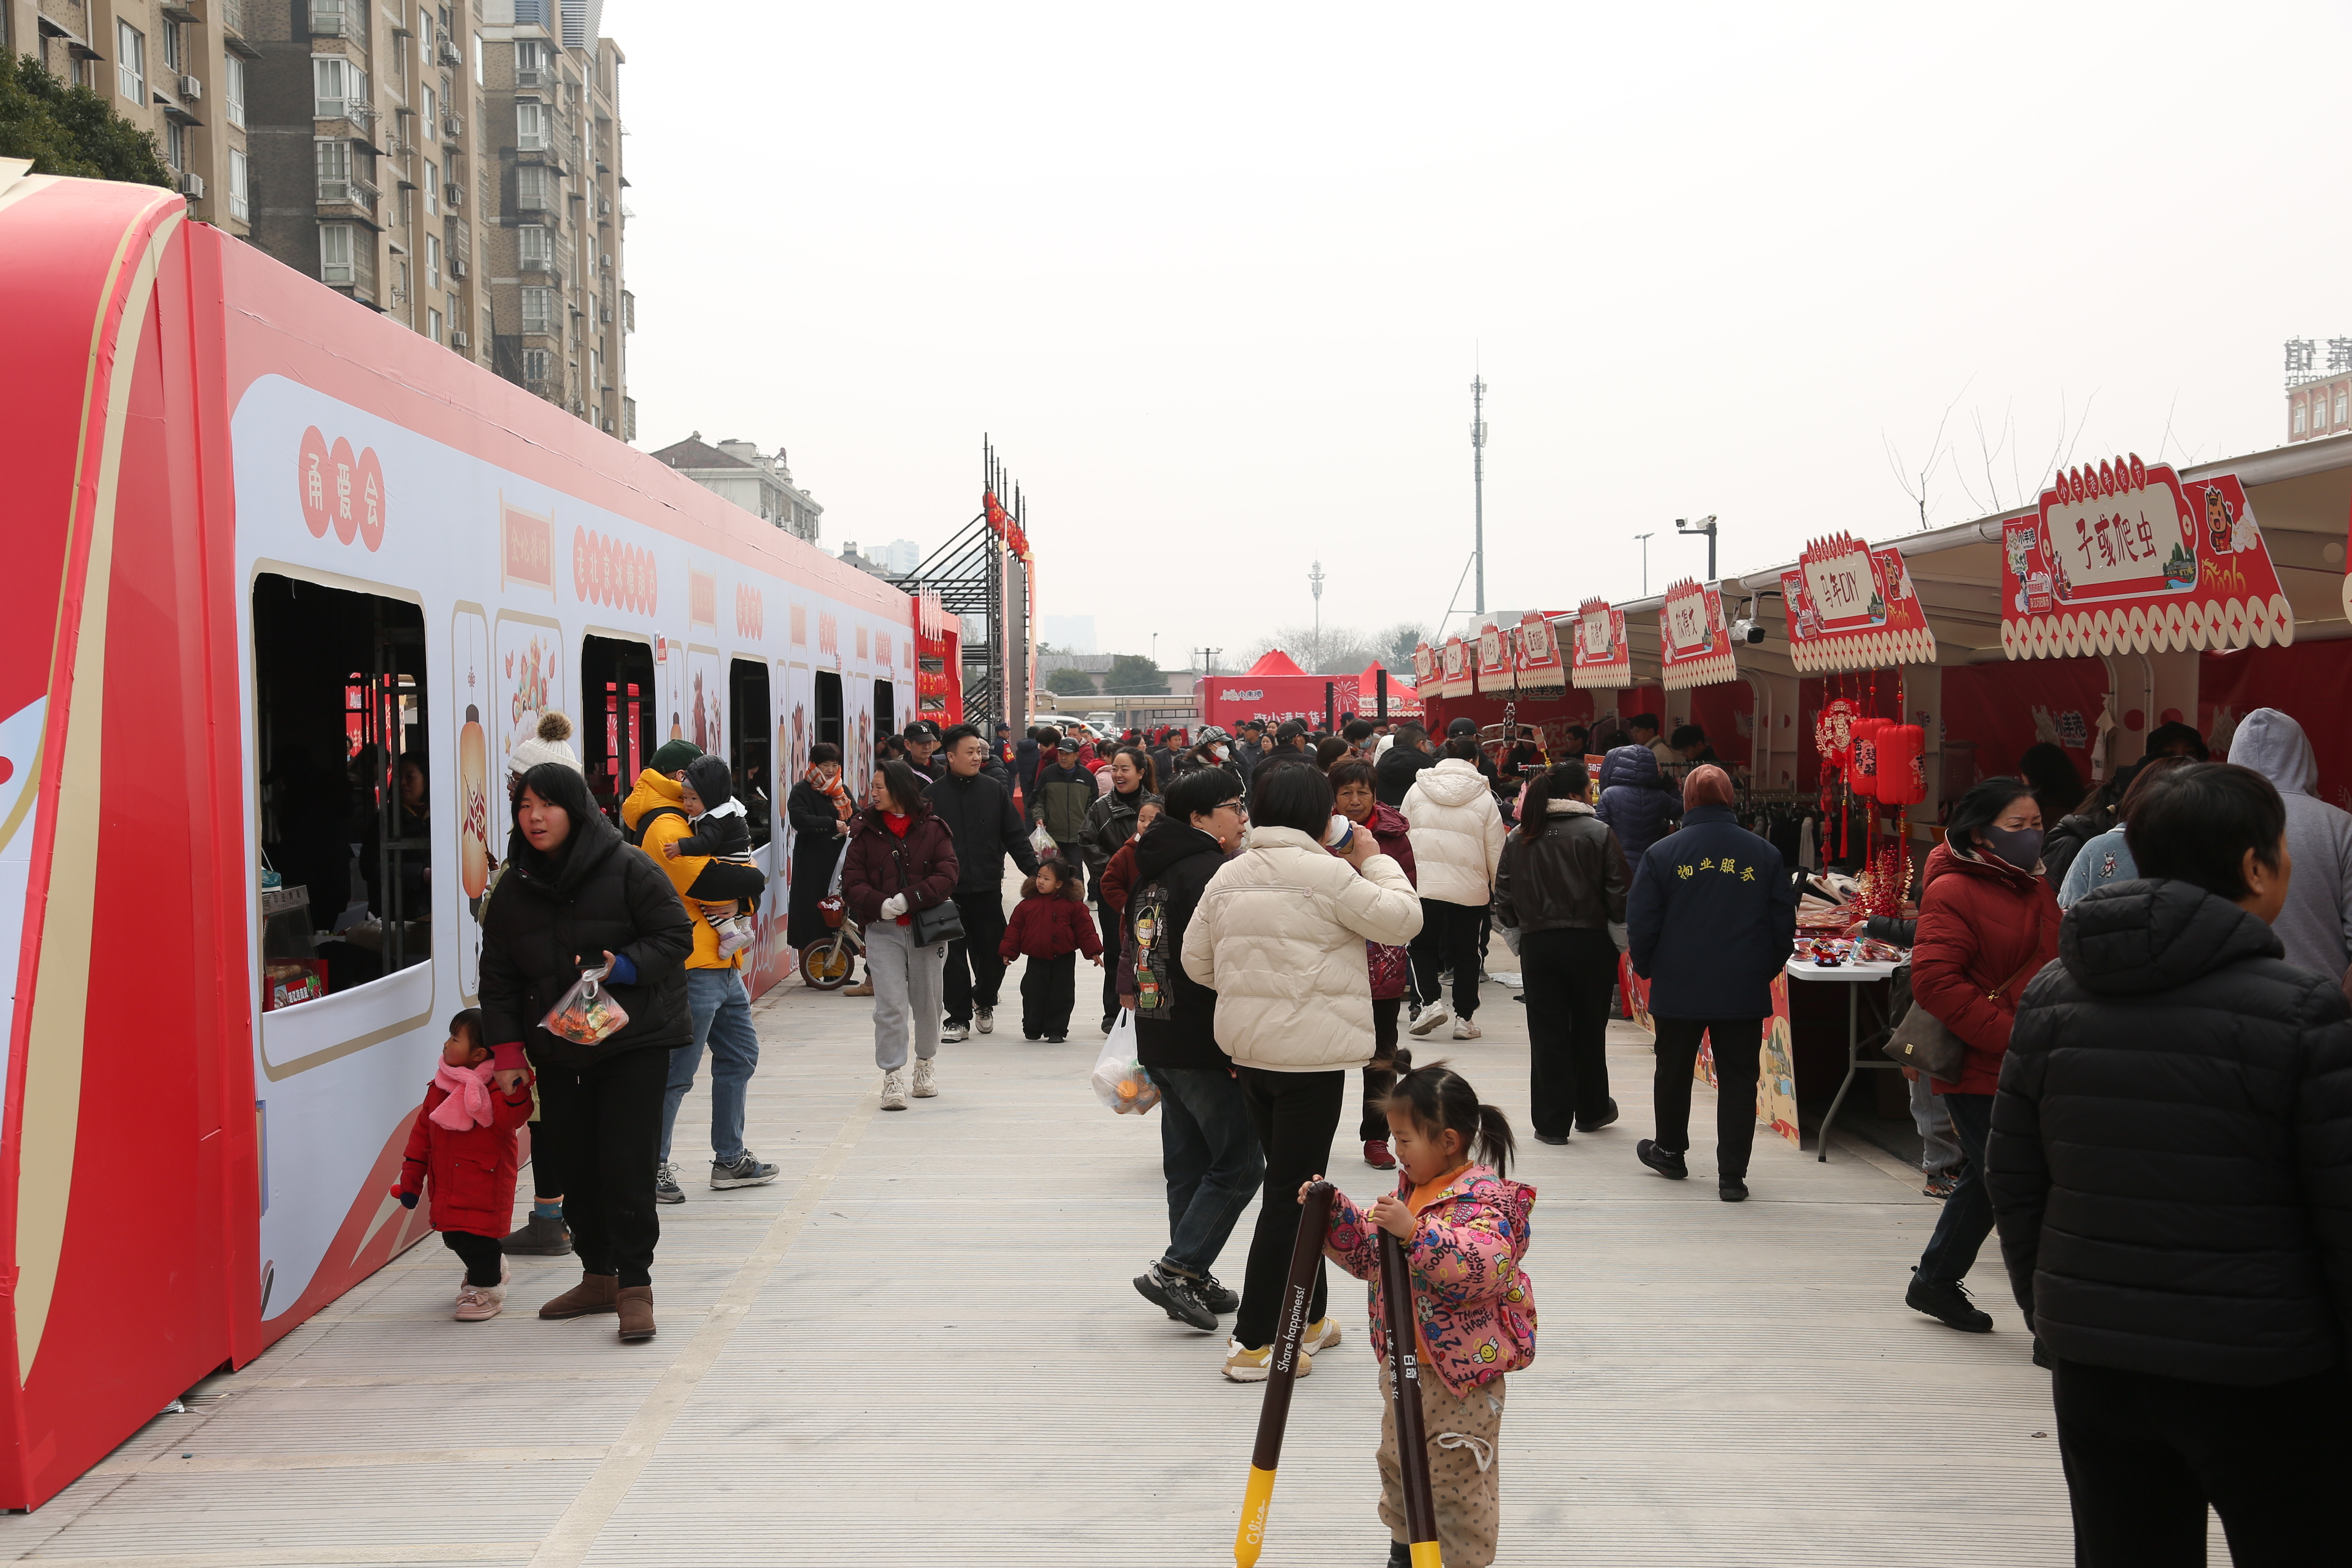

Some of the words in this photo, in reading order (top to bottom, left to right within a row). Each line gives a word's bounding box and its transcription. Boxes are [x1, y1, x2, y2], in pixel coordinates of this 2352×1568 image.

[308, 453, 378, 528] 甬爱会
[2060, 463, 2142, 499] 小丰港年货节
[2018, 530, 2036, 545] 小丰港
[577, 543, 655, 602] 老北京冰糖葫芦
[1820, 570, 1860, 608] 马年DIY
[2054, 713, 2086, 737] 小丰港
[1677, 858, 1755, 881] 物业服务
[1283, 1285, 1305, 1341] happiness!
[1454, 1304, 1486, 1321] THINGS
[1277, 1342, 1293, 1373] Share
[1403, 1354, 1417, 1379] 百奇
[1246, 1499, 1265, 1545] Glico
